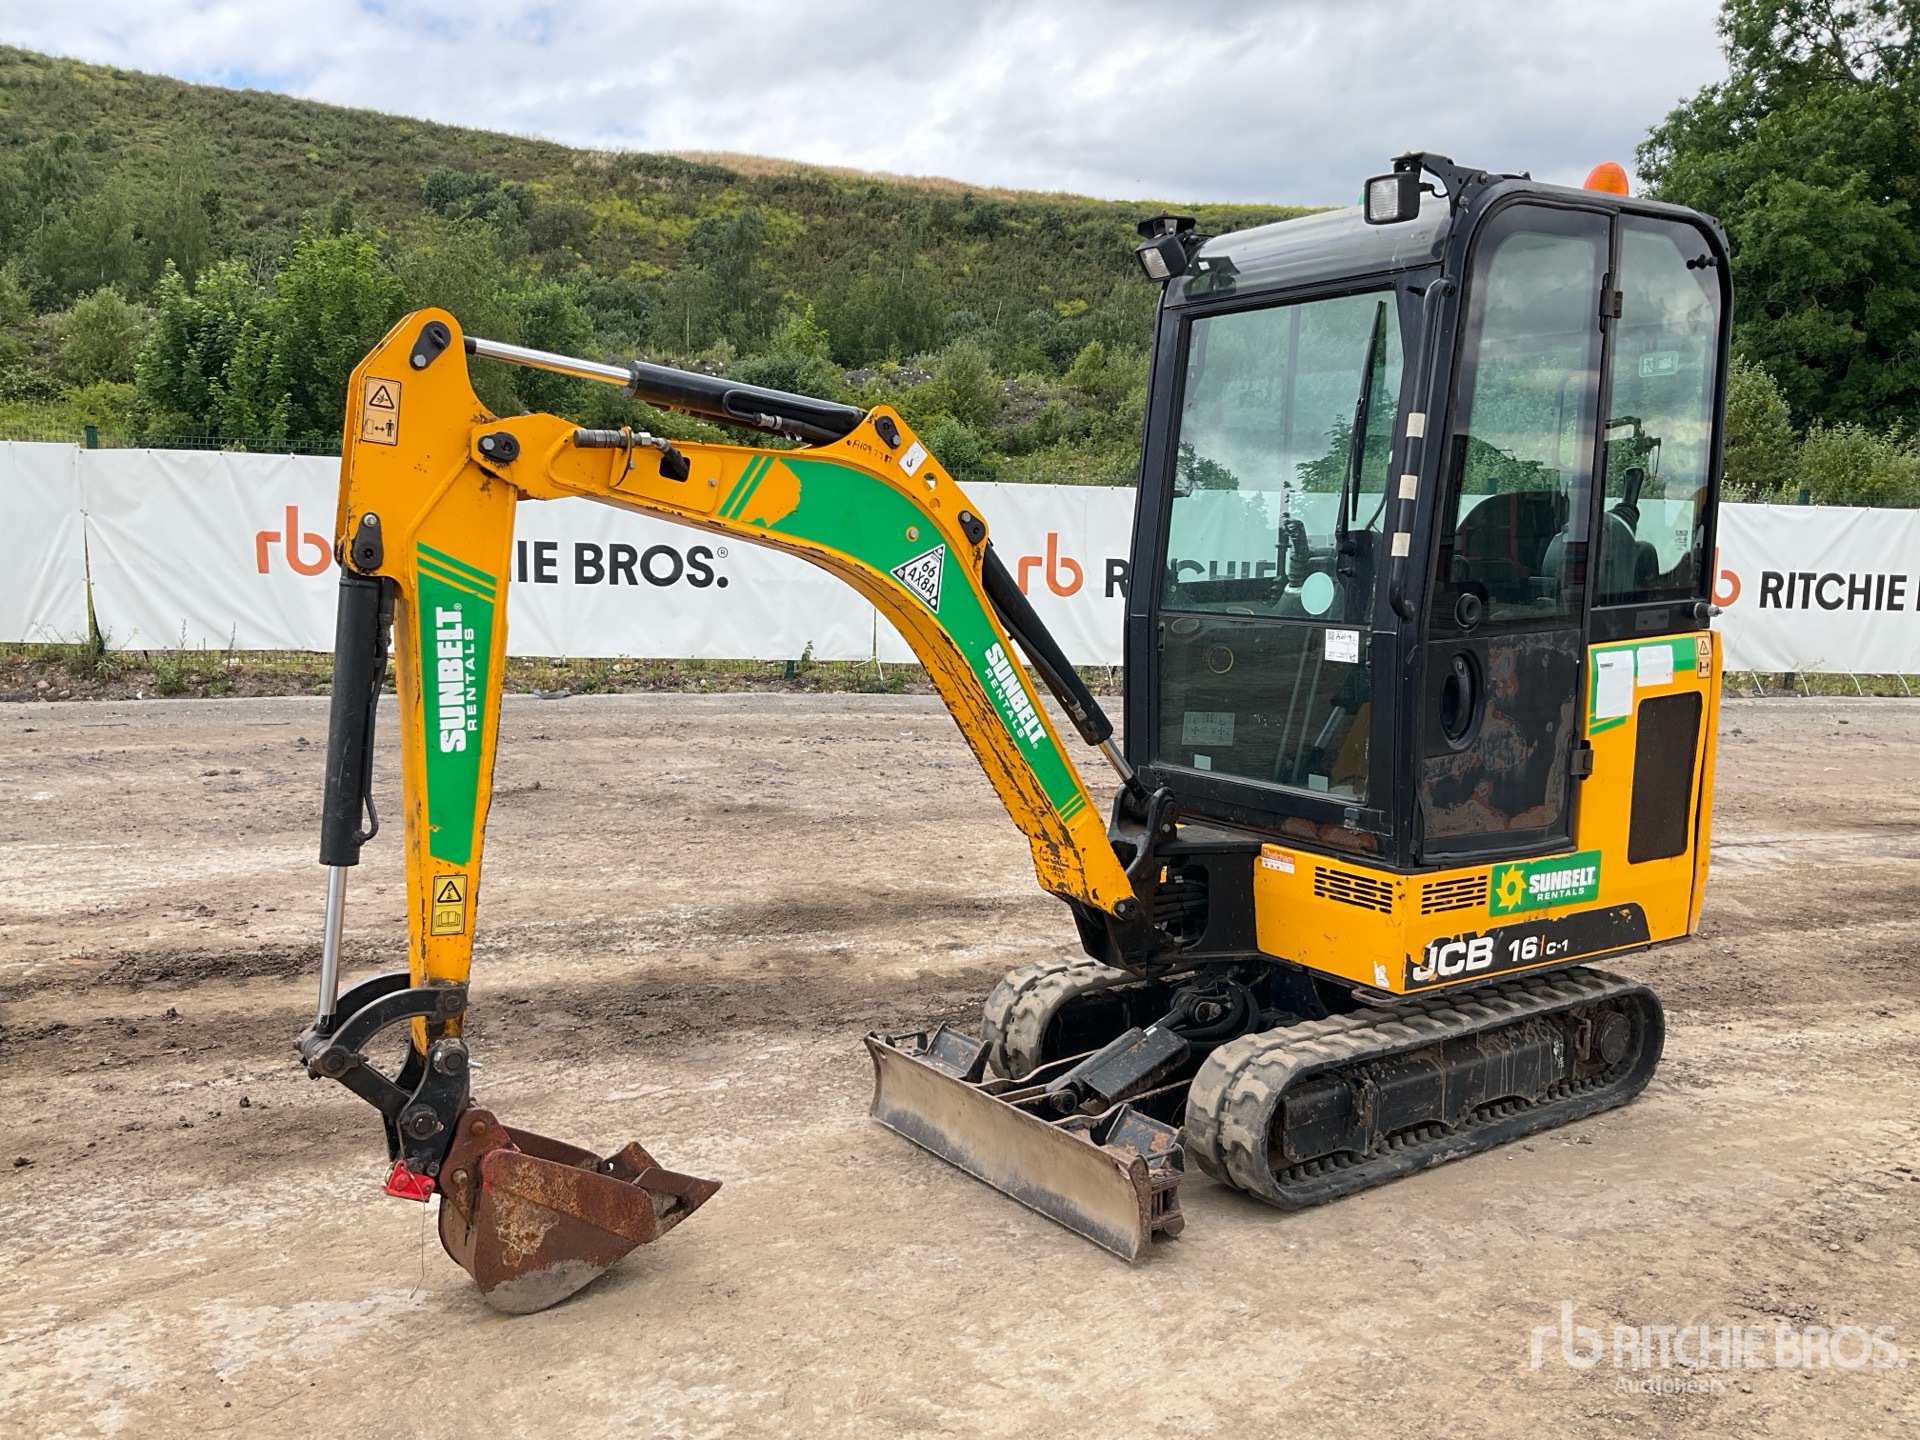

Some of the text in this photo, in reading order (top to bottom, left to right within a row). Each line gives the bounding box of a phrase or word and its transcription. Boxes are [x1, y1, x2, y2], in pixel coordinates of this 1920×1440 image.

[256, 505, 332, 576] rb
[907, 567, 936, 597] AX8A
[921, 560, 937, 578] 66
[1711, 547, 1741, 607] b
[1759, 571, 1908, 611] RITCHIE
[436, 606, 467, 752] SUNBELT
[464, 628, 477, 731] RENTALS
[984, 642, 1047, 745] SUNBELT
[984, 667, 1025, 739] RENTALS
[1263, 848, 1294, 864] Thatcham
[1528, 866, 1596, 894] SUNBELT
[1536, 887, 1585, 901] RENTALS
[1412, 936, 1494, 982] JCB
